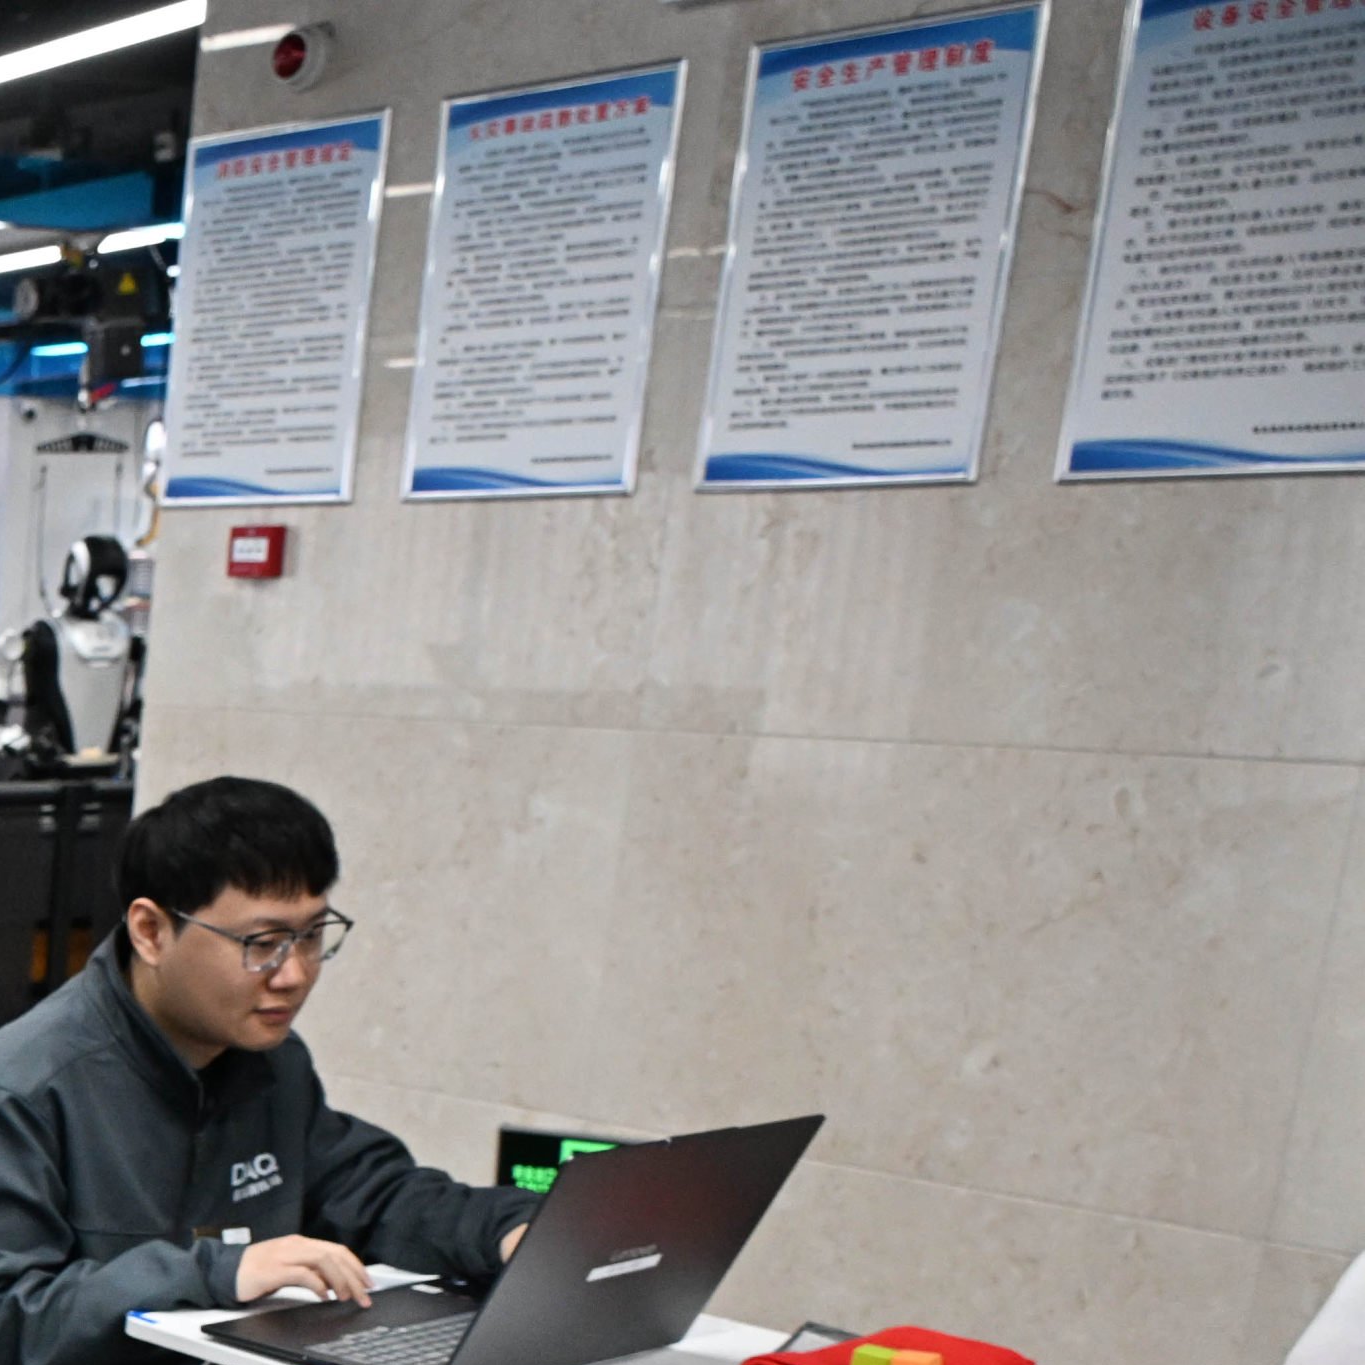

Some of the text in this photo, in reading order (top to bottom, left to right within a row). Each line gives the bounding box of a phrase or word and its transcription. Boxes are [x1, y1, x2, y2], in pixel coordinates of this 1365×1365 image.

[792, 38, 995, 91] 安全生产管理制度
